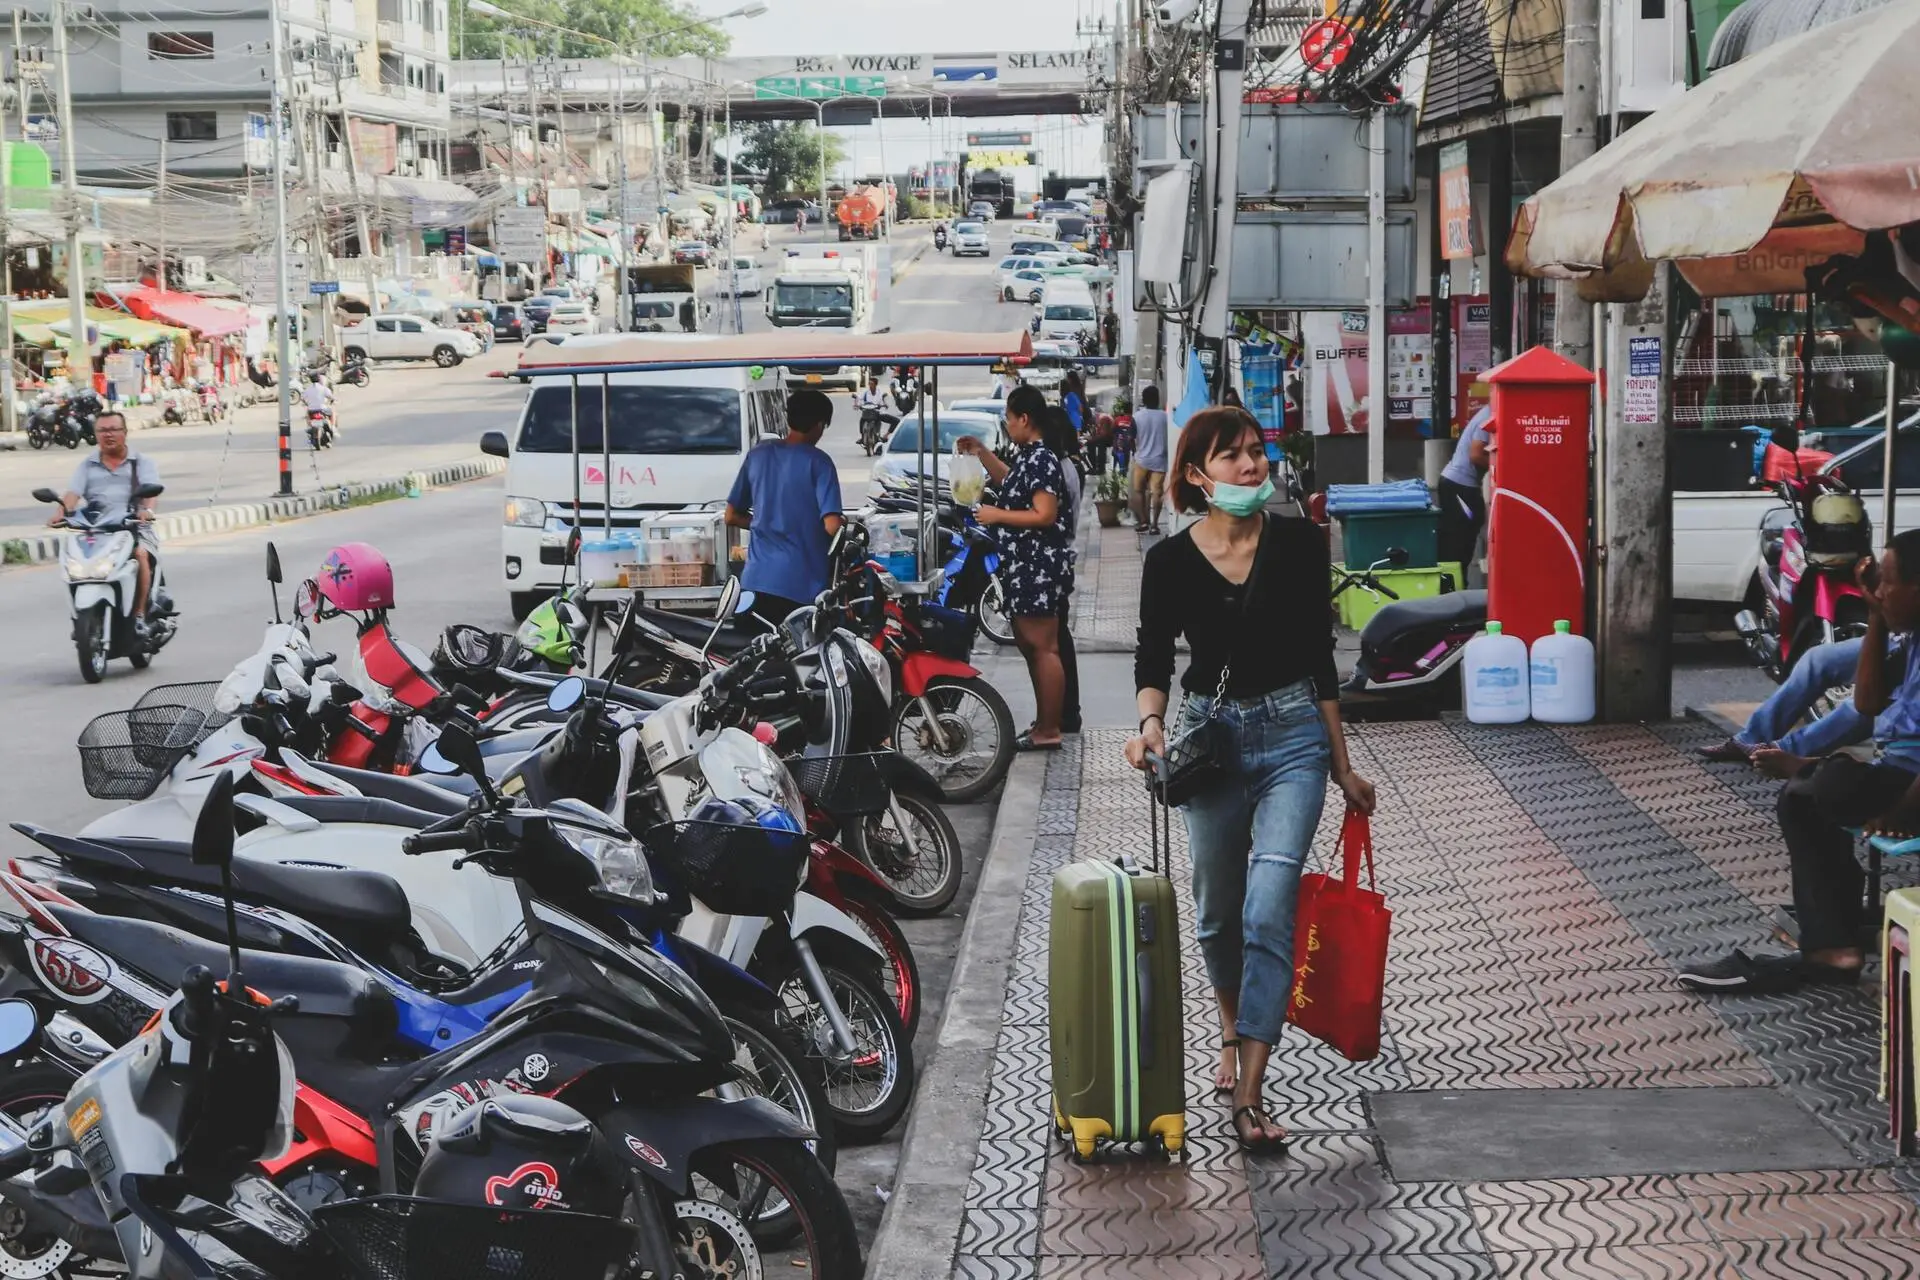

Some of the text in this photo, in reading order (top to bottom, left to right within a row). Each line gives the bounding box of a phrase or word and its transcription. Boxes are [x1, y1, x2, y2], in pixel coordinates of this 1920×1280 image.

[796, 55, 921, 72] BON VOYAGE
[1008, 52, 1089, 69] SELAMA
[1472, 307, 1489, 316] VAT
[1344, 318, 1366, 331] 299
[1316, 348, 1368, 359] BUFFE
[1393, 400, 1409, 408] VAT
[1516, 415, 1570, 425] รหัสไปรษณีย์
[1525, 434, 1562, 444] 90320
